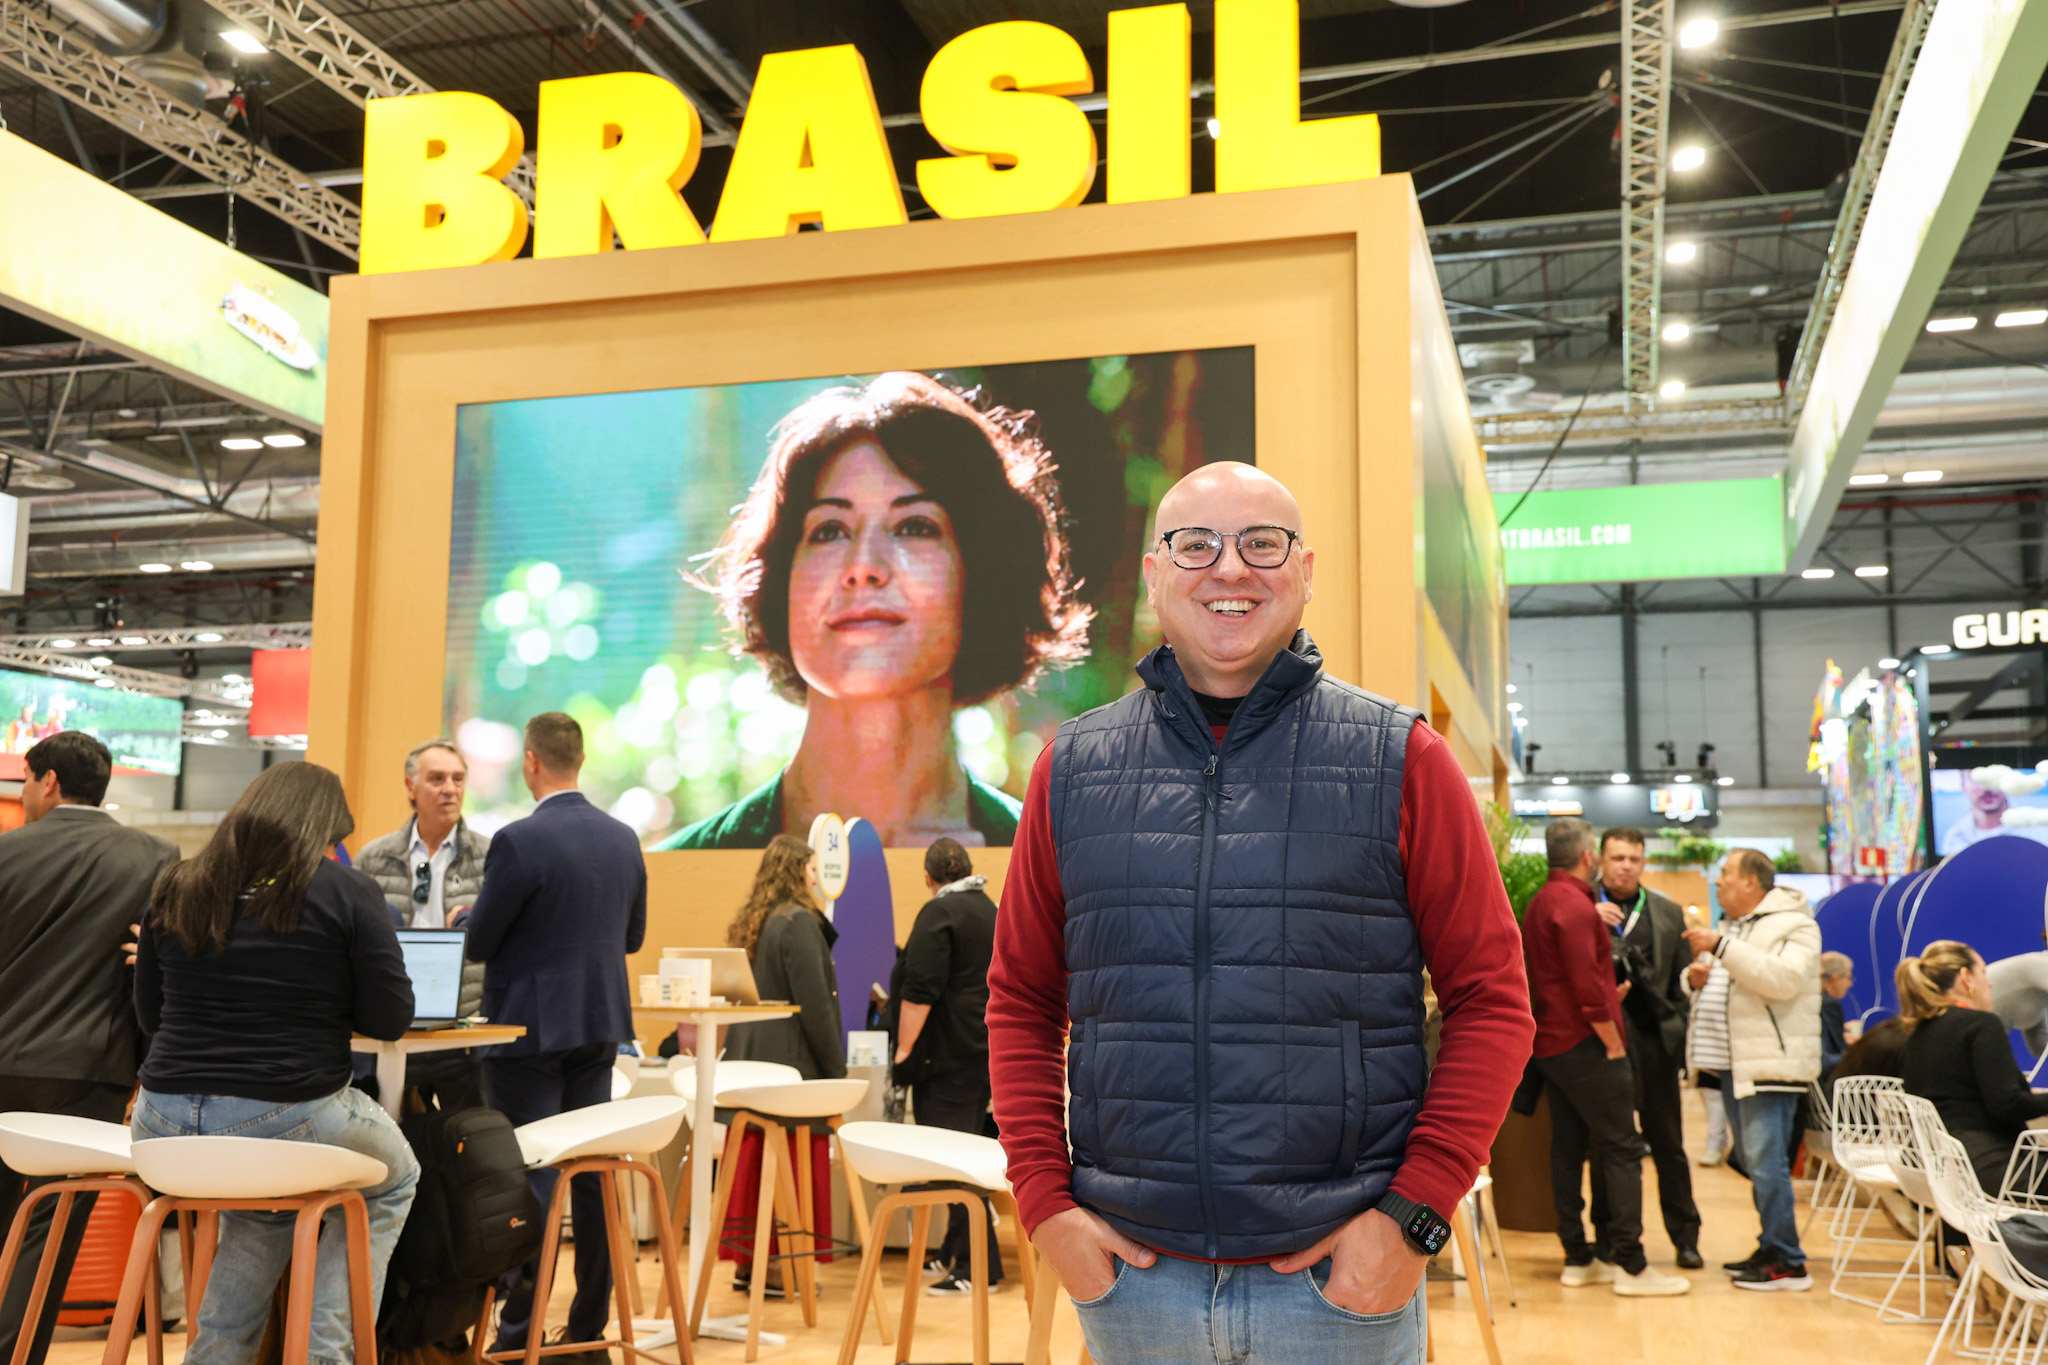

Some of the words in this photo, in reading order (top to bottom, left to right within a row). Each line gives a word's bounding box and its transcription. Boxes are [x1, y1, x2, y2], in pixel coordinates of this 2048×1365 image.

[359, 0, 1381, 275] BRASIL
[1952, 608, 2048, 650] GUA
[828, 832, 838, 851] 34
[1425, 1225, 1441, 1245] 10:59
